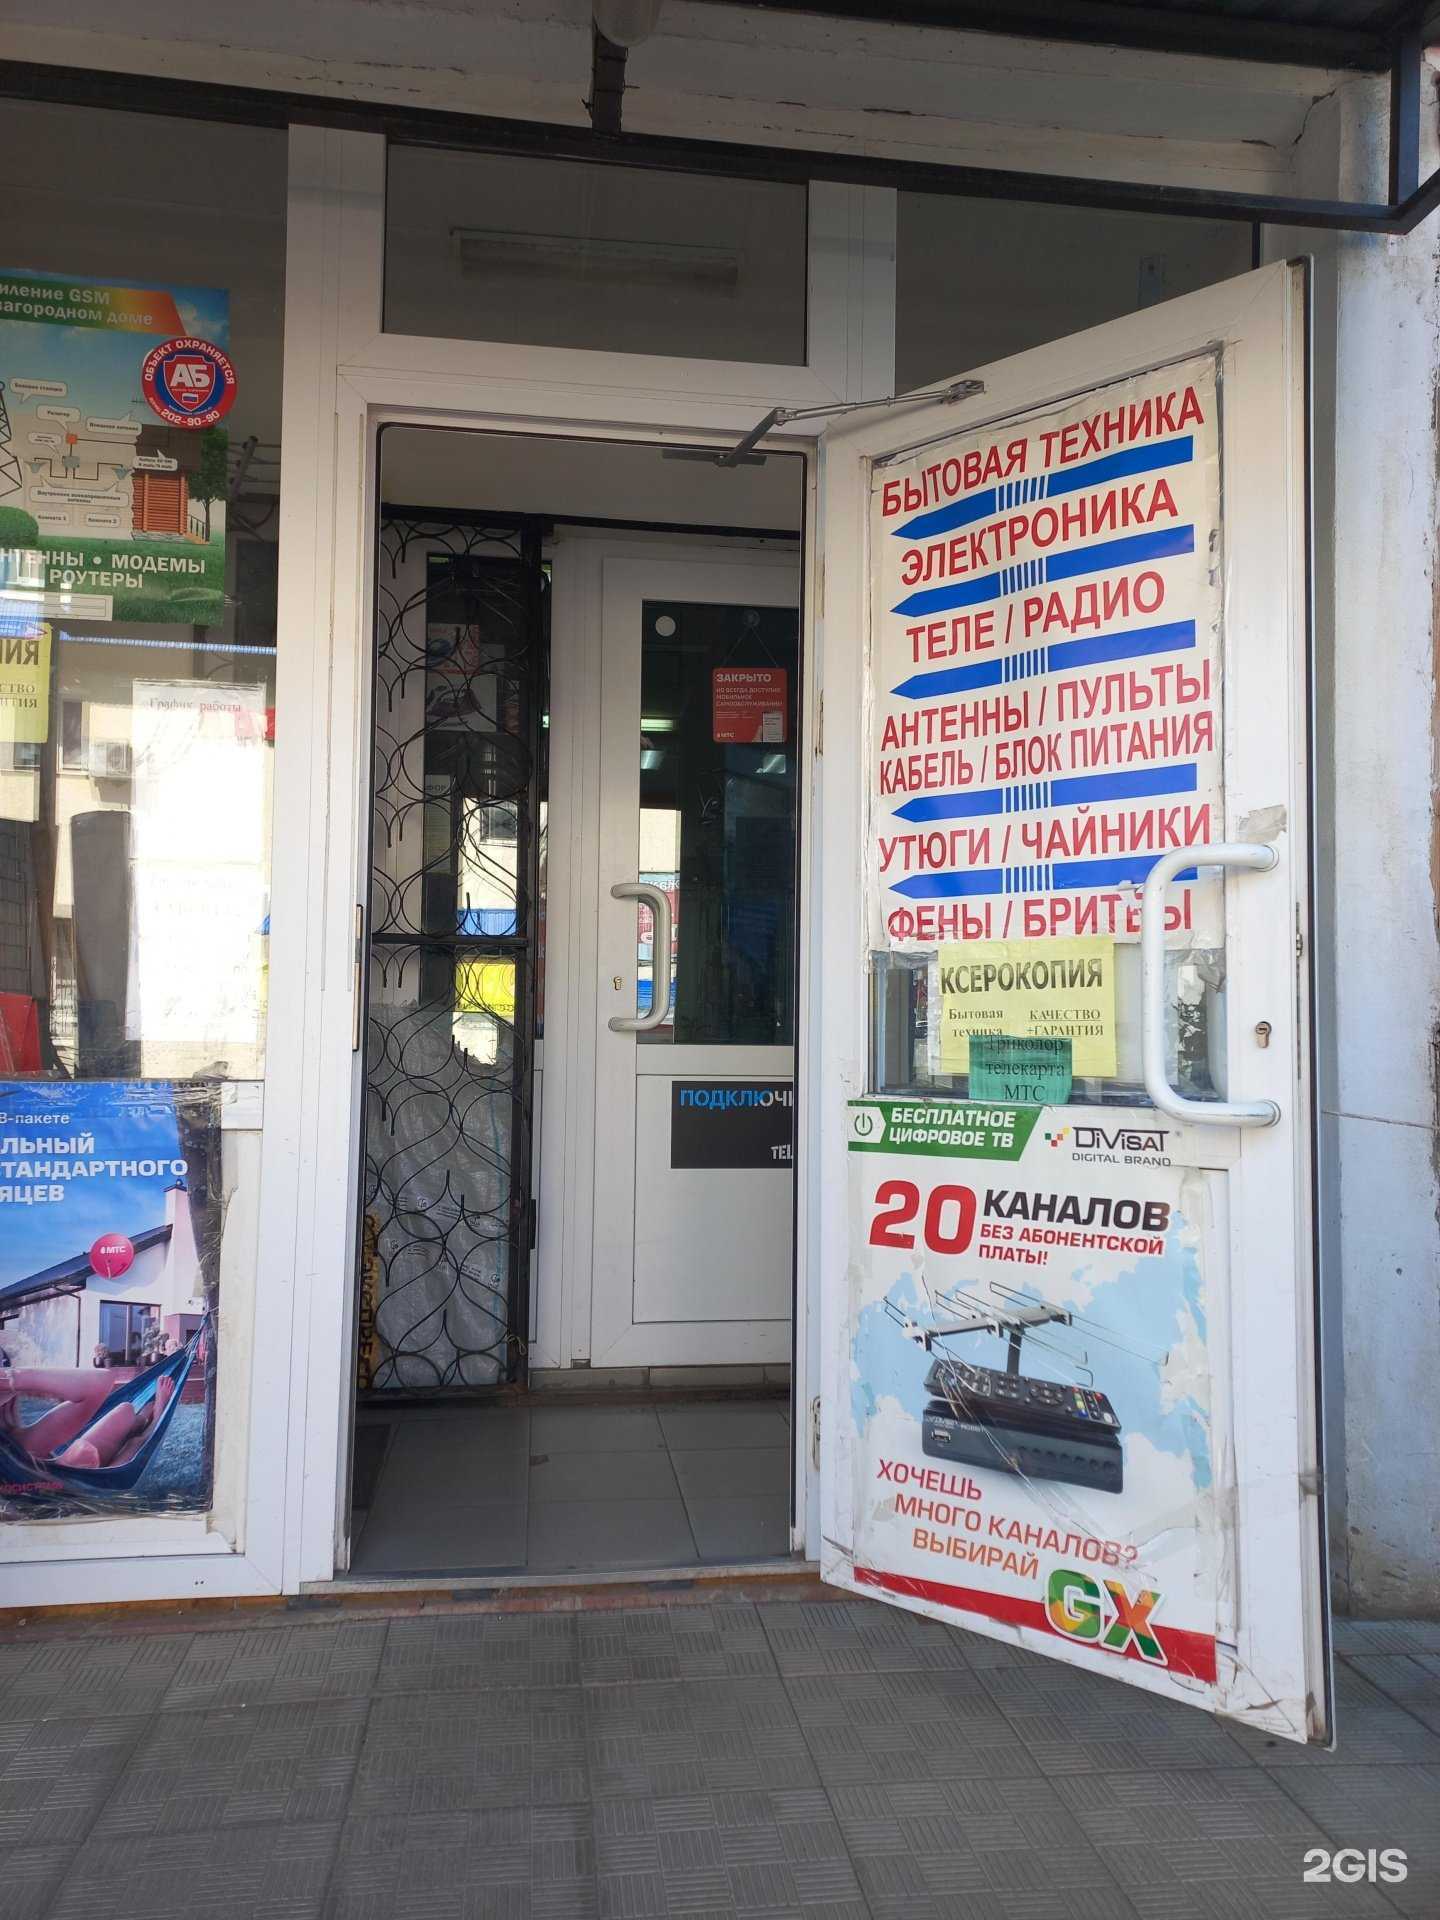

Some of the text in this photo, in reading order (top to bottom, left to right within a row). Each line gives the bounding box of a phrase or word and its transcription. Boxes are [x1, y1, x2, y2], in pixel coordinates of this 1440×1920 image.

[69, 288, 111, 305] GSM
[107, 312, 153, 326] доме
[144, 339, 236, 385] ОБЪЕКТ ОХРАНЯЕТСЯ
[170, 363, 210, 388] АБ
[161, 408, 220, 426] 202-90-90
[882, 386, 1204, 517] БЫТОВАЯ ТЕХНИКА
[901, 478, 1179, 586] ЭЛЕКТРОНИКА
[111, 553, 206, 574] МОДЕМЫ
[50, 569, 143, 589] РОУТЕРЫ
[906, 610, 995, 663] ТЕЛЕ
[1024, 571, 1165, 637] РАДИО
[716, 673, 772, 682] ЗАКРЫТО
[881, 690, 1029, 752] АНТЕННЫ
[1057, 658, 1210, 723] ПУЛЬТЫ
[880, 749, 973, 795] КАБЕЛЬ
[995, 733, 1062, 781] БЛОК
[1070, 710, 1214, 769] ПИТАНИЯ
[878, 828, 990, 873] УТЮГИ
[1021, 804, 1210, 859] ЧАЙНИКИ
[887, 902, 992, 942] ФЕНЫ
[941, 958, 1102, 994] КСЕРОКОПИЯ
[949, 1008, 1101, 1020] Бытовая КАЧЕСТВО
[951, 1024, 1104, 1037] техника +ГАРАНТИЯ
[985, 1062, 1065, 1080] телекарта
[1004, 1084, 1045, 1101] МТС
[891, 1108, 1016, 1128] БЕСПЛАТНОЕ
[0, 1132, 95, 1154] ЛЬНЫЙ
[889, 1127, 1014, 1148] ЦИФРОВОЕ ТВ
[1072, 1152, 1171, 1167] DIGITAL BRAND
[0, 1184, 65, 1205] ЯЦЕВ
[869, 1180, 1170, 1255] 20 КАНАЛОВ
[106, 1246, 126, 1254] МТС
[980, 1223, 1164, 1255] БЕЗ АБОНЕНТСКОЙ
[978, 1245, 1047, 1266] ПЛАТЫ!
[877, 1459, 982, 1500] ХОЧЕШЬ
[894, 1493, 1138, 1570] МНОГО КАНАЛОВ?
[912, 1528, 1039, 1579] ВЫБИРАЙ
[1044, 1568, 1168, 1666] GX
